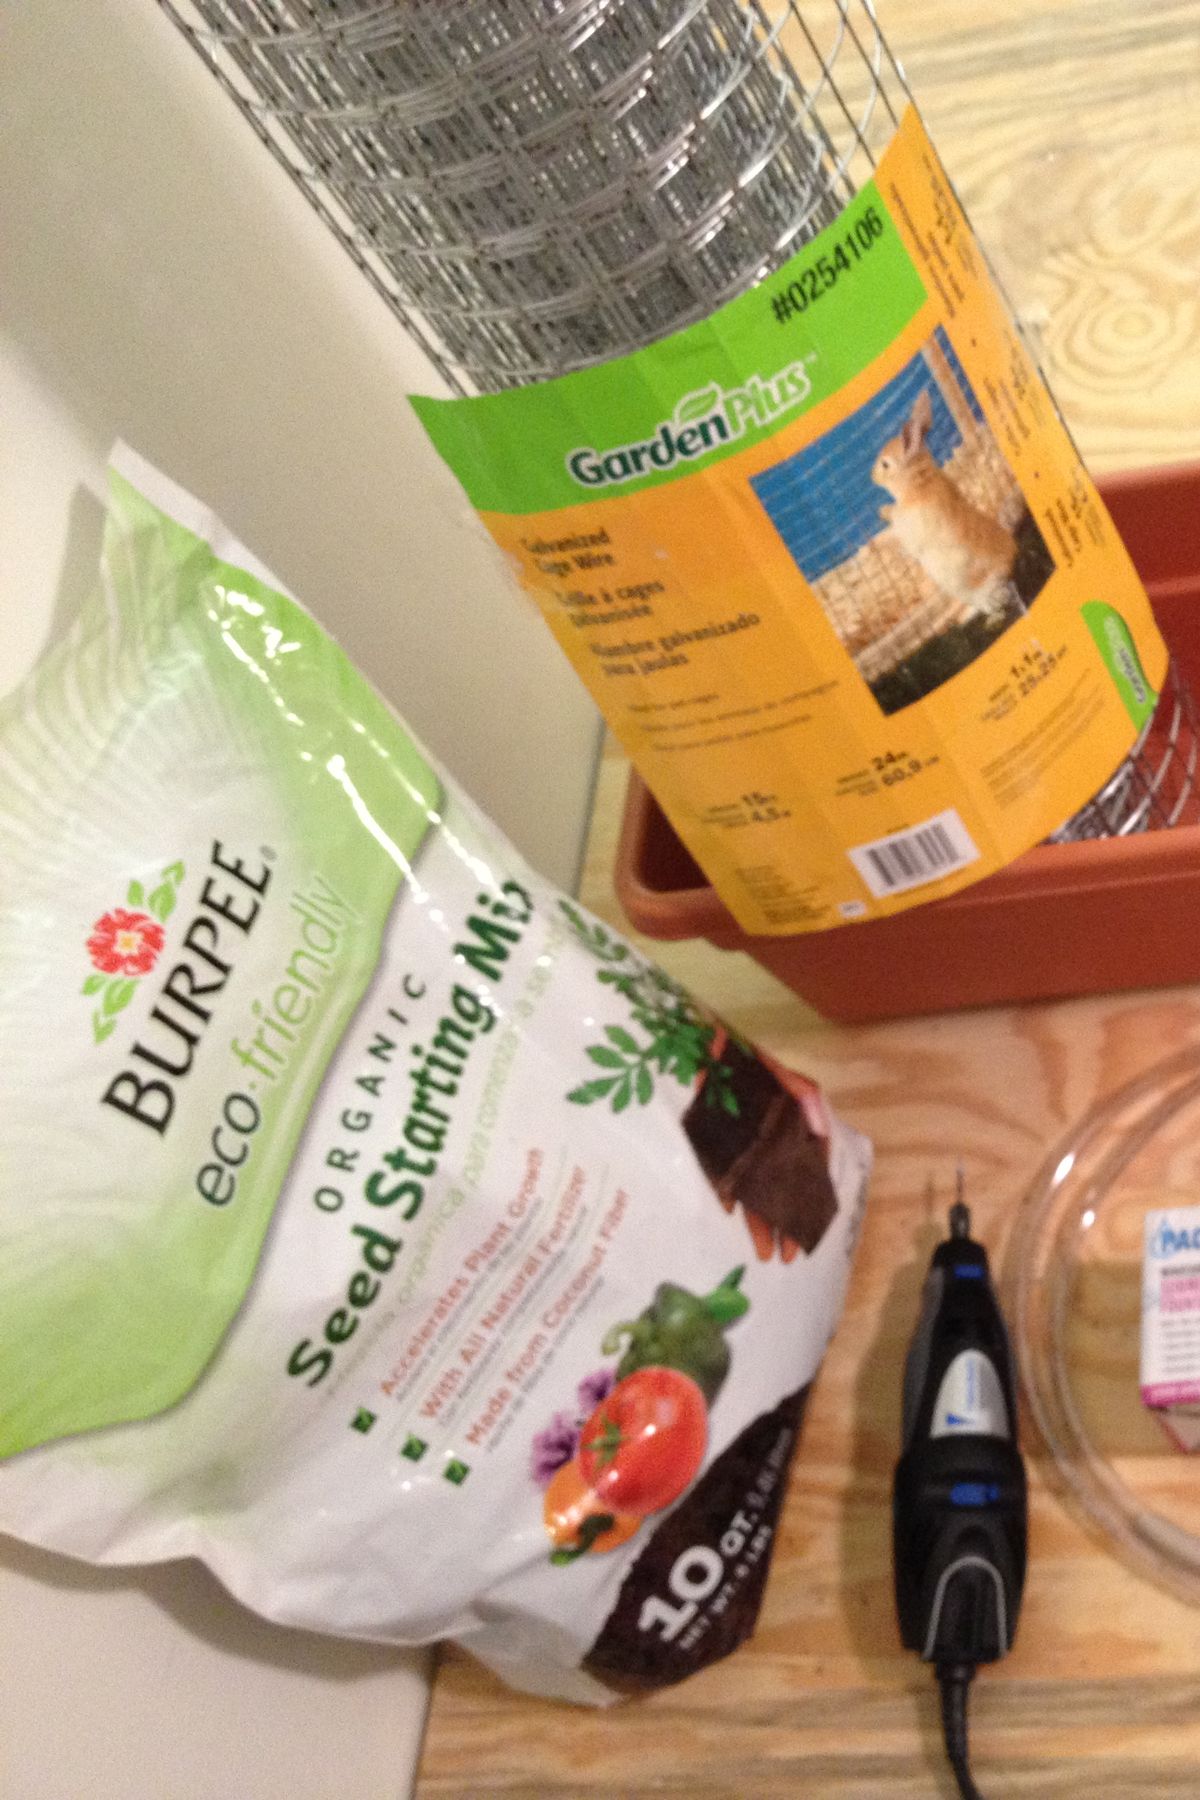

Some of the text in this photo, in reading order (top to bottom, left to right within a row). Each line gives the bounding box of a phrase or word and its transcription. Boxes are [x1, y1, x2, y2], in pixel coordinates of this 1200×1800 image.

[770, 205, 884, 325] #0254106
[101, 839, 274, 1138] BURPEE
[314, 972, 427, 1214] ORGANIC
[286, 1223, 402, 1389] Seed
[364, 982, 498, 1222] Starting
[380, 1147, 544, 1396] Accelerates Plant Growth
[420, 1164, 587, 1418] With All Natural Fertilizer
[465, 1387, 513, 1446] Made
[505, 1332, 547, 1382] from
[543, 1244, 607, 1330] Coconut
[637, 1544, 725, 1642] 10
